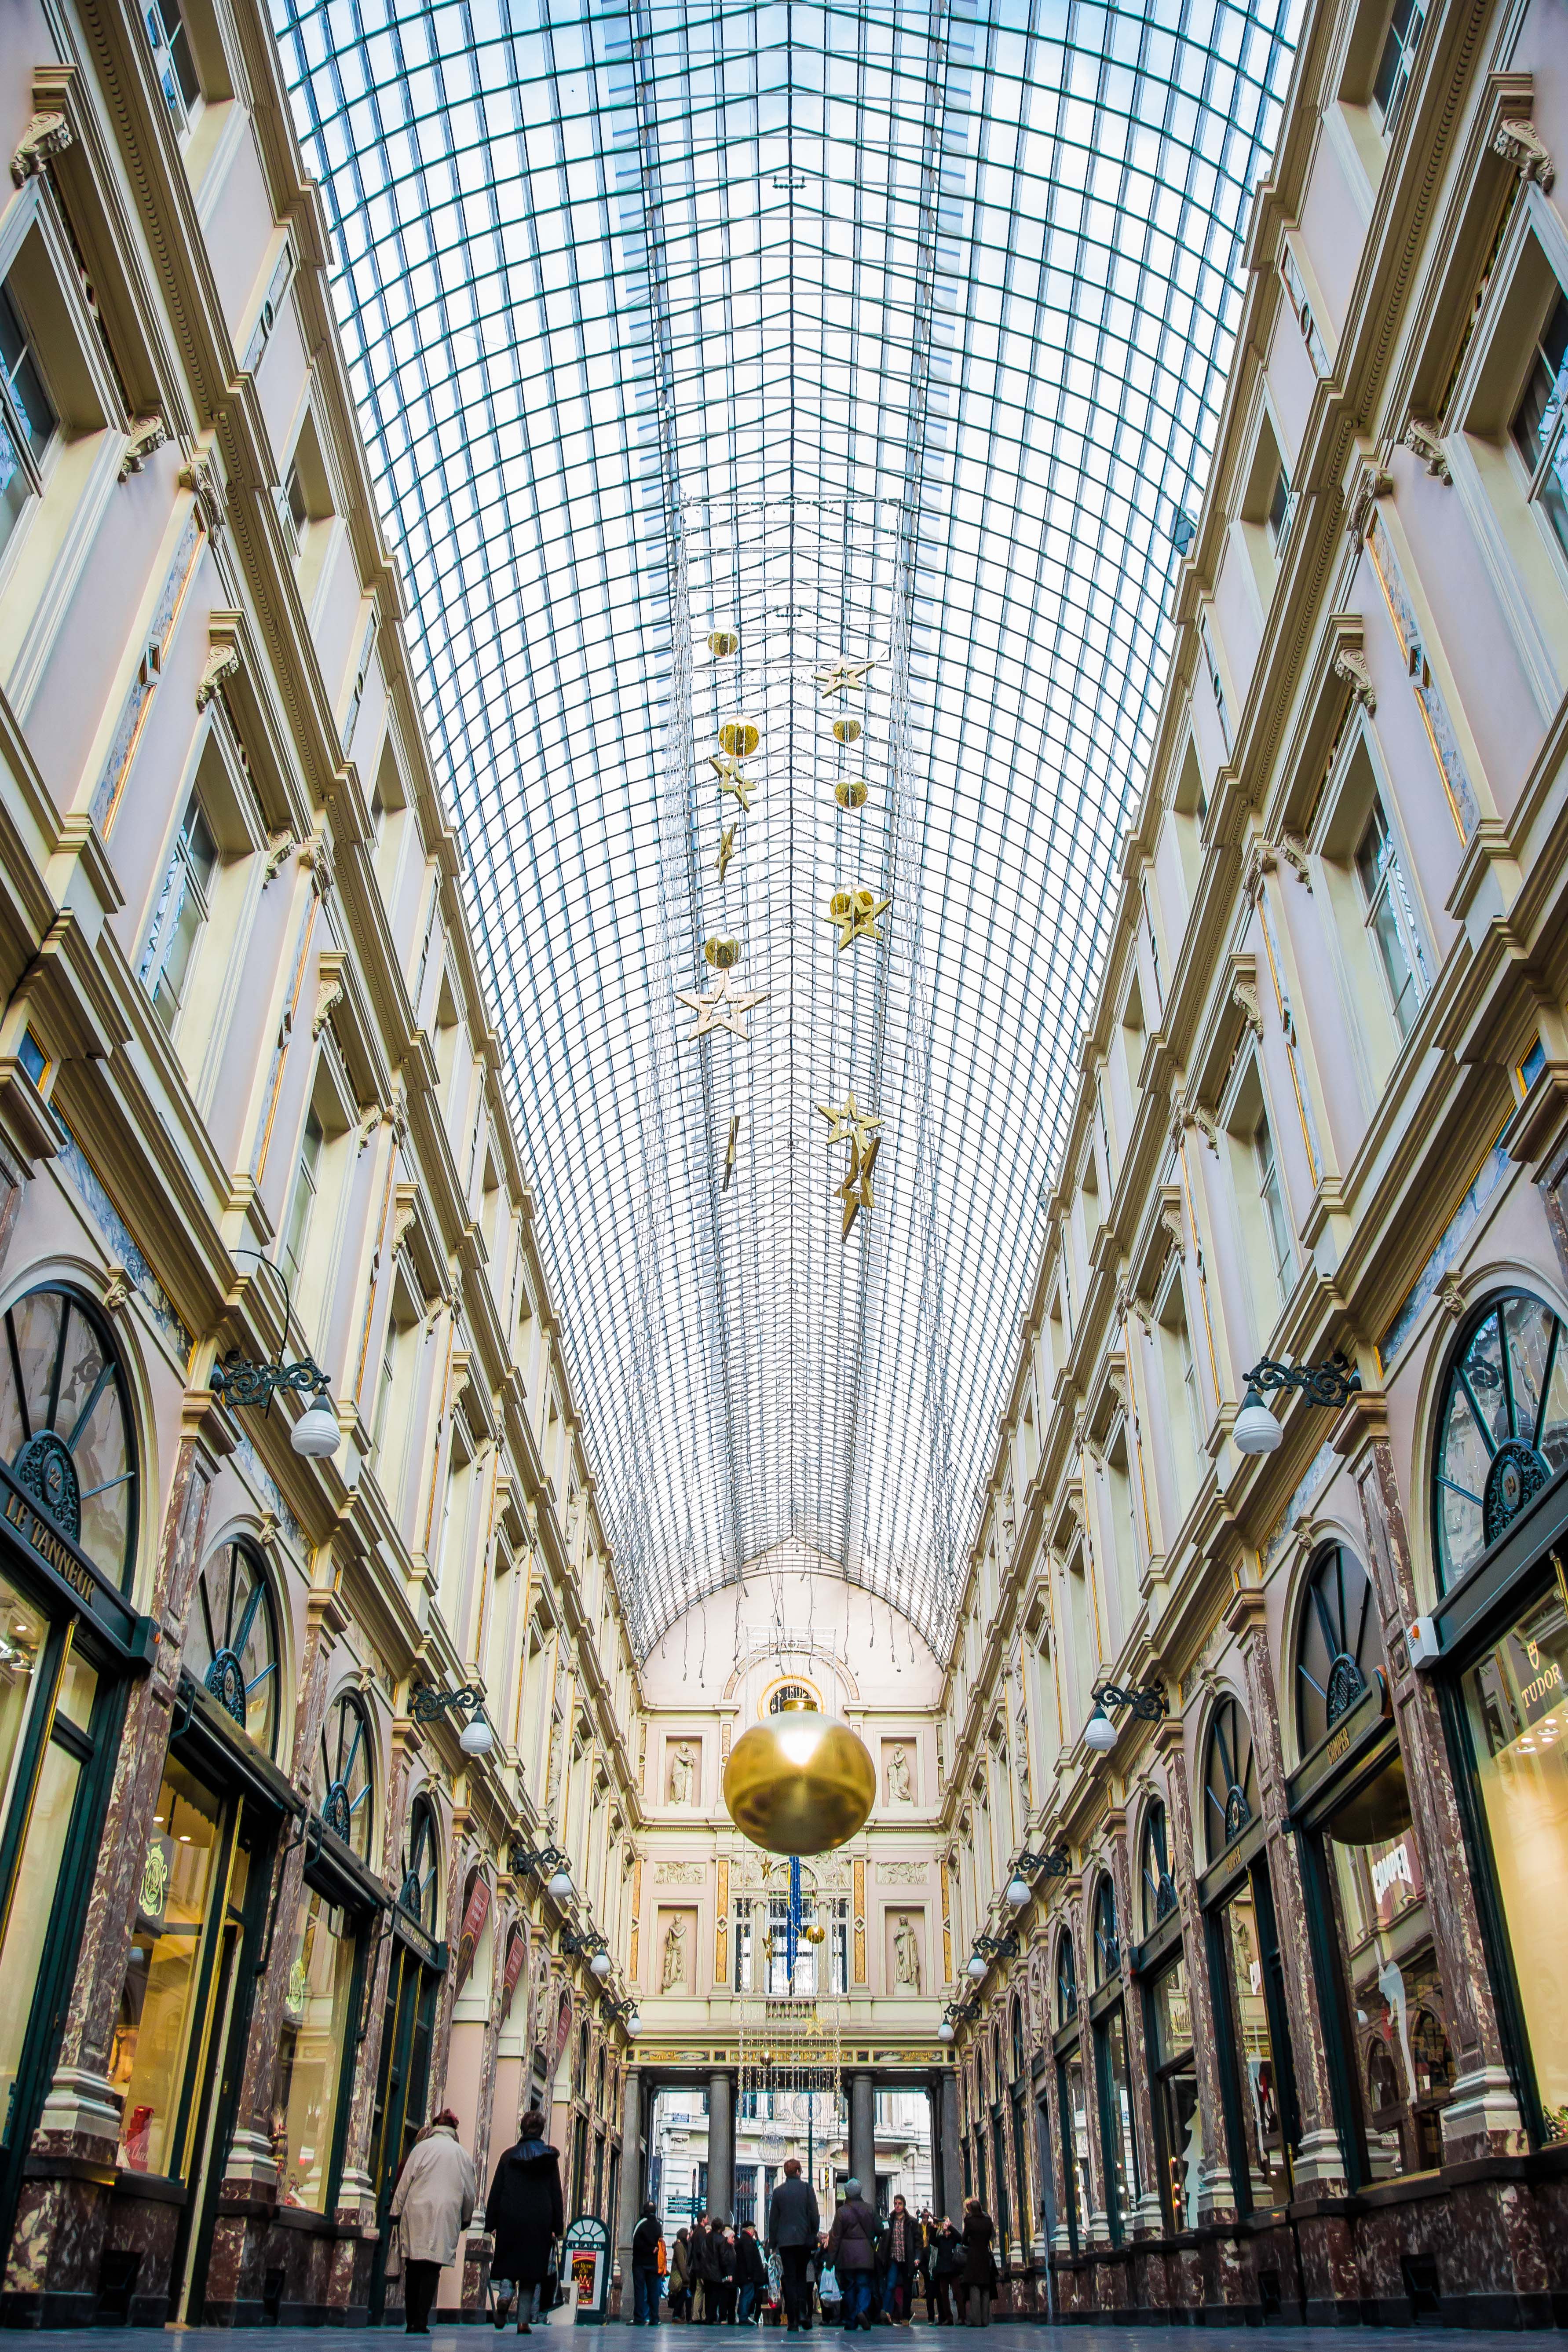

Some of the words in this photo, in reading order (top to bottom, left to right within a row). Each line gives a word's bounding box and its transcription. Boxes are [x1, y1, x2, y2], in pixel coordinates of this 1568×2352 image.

[5, 1492, 28, 1532] LE
[30, 1518, 96, 1607] TANNEUR
[1521, 1663, 1562, 1708] TUDOR
[1326, 1726, 1350, 1765] CAMPER
